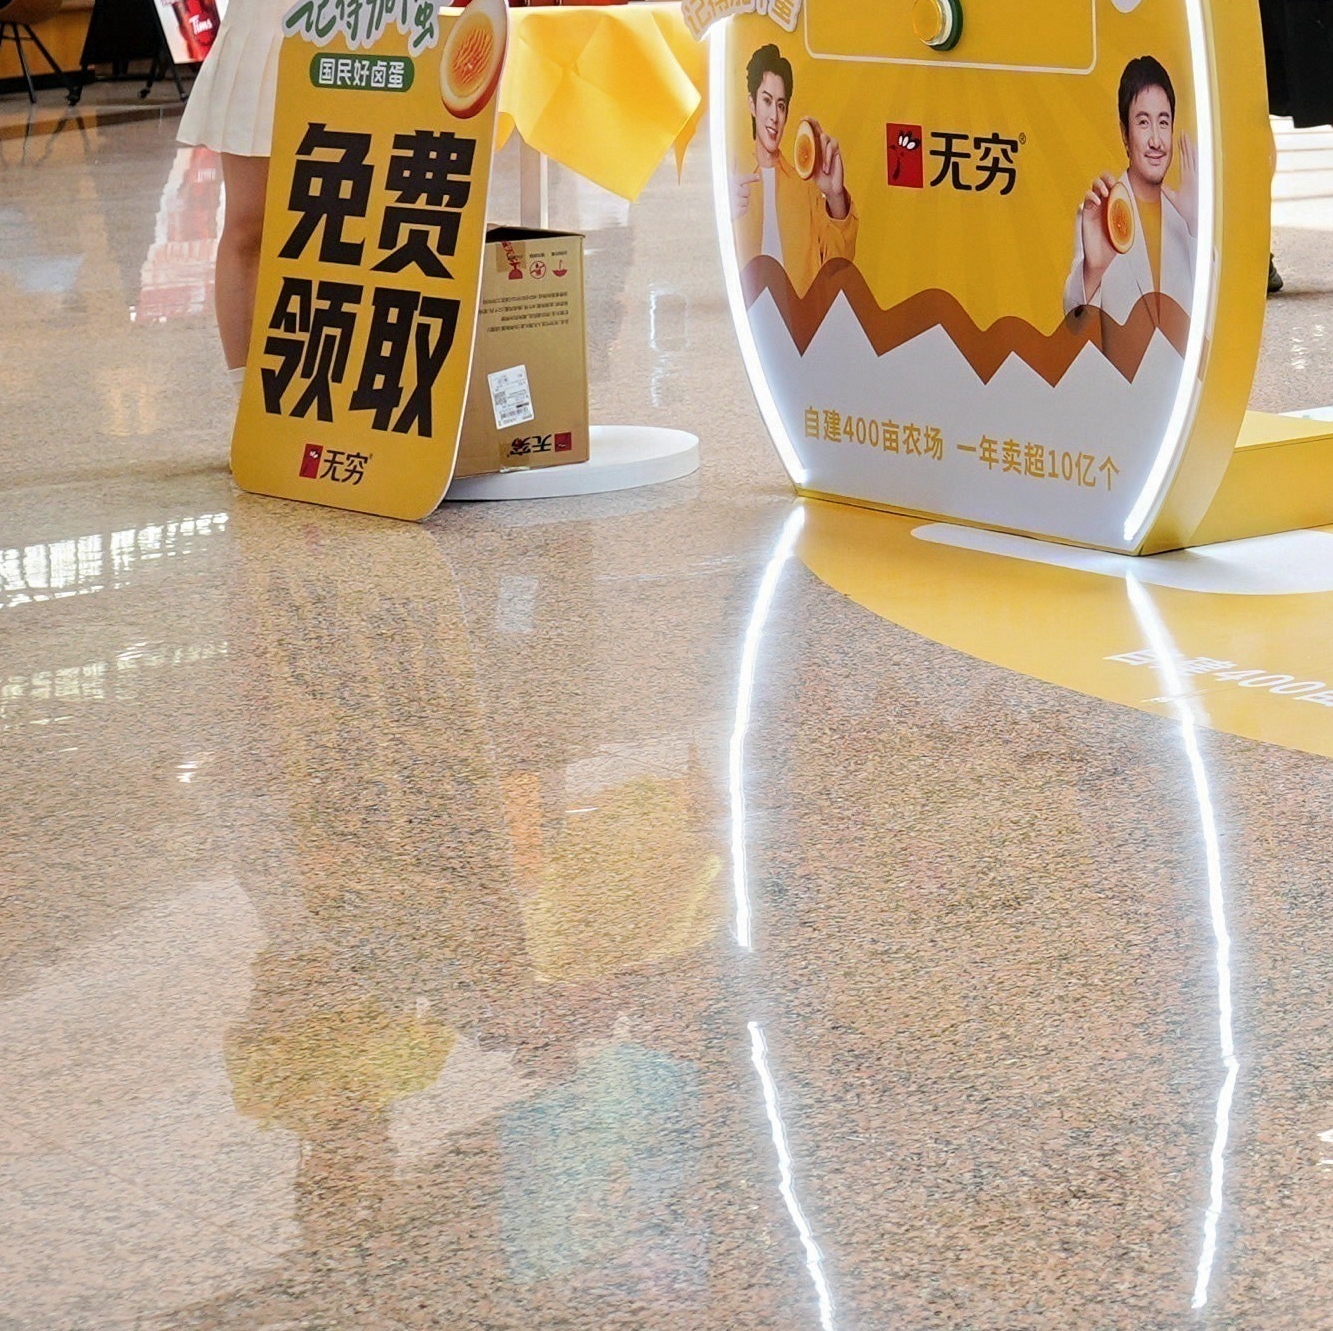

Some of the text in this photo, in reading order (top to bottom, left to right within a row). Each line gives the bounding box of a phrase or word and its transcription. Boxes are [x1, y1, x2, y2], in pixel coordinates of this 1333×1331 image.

[318, 59, 406, 90] 国民好卤蛋
[928, 130, 1020, 196] 无穷
[278, 122, 477, 280] 免费
[259, 276, 461, 439] 领取
[323, 447, 370, 486] 无穷
[803, 406, 1121, 491] 自建400亩农场 一年卖超10亿个
